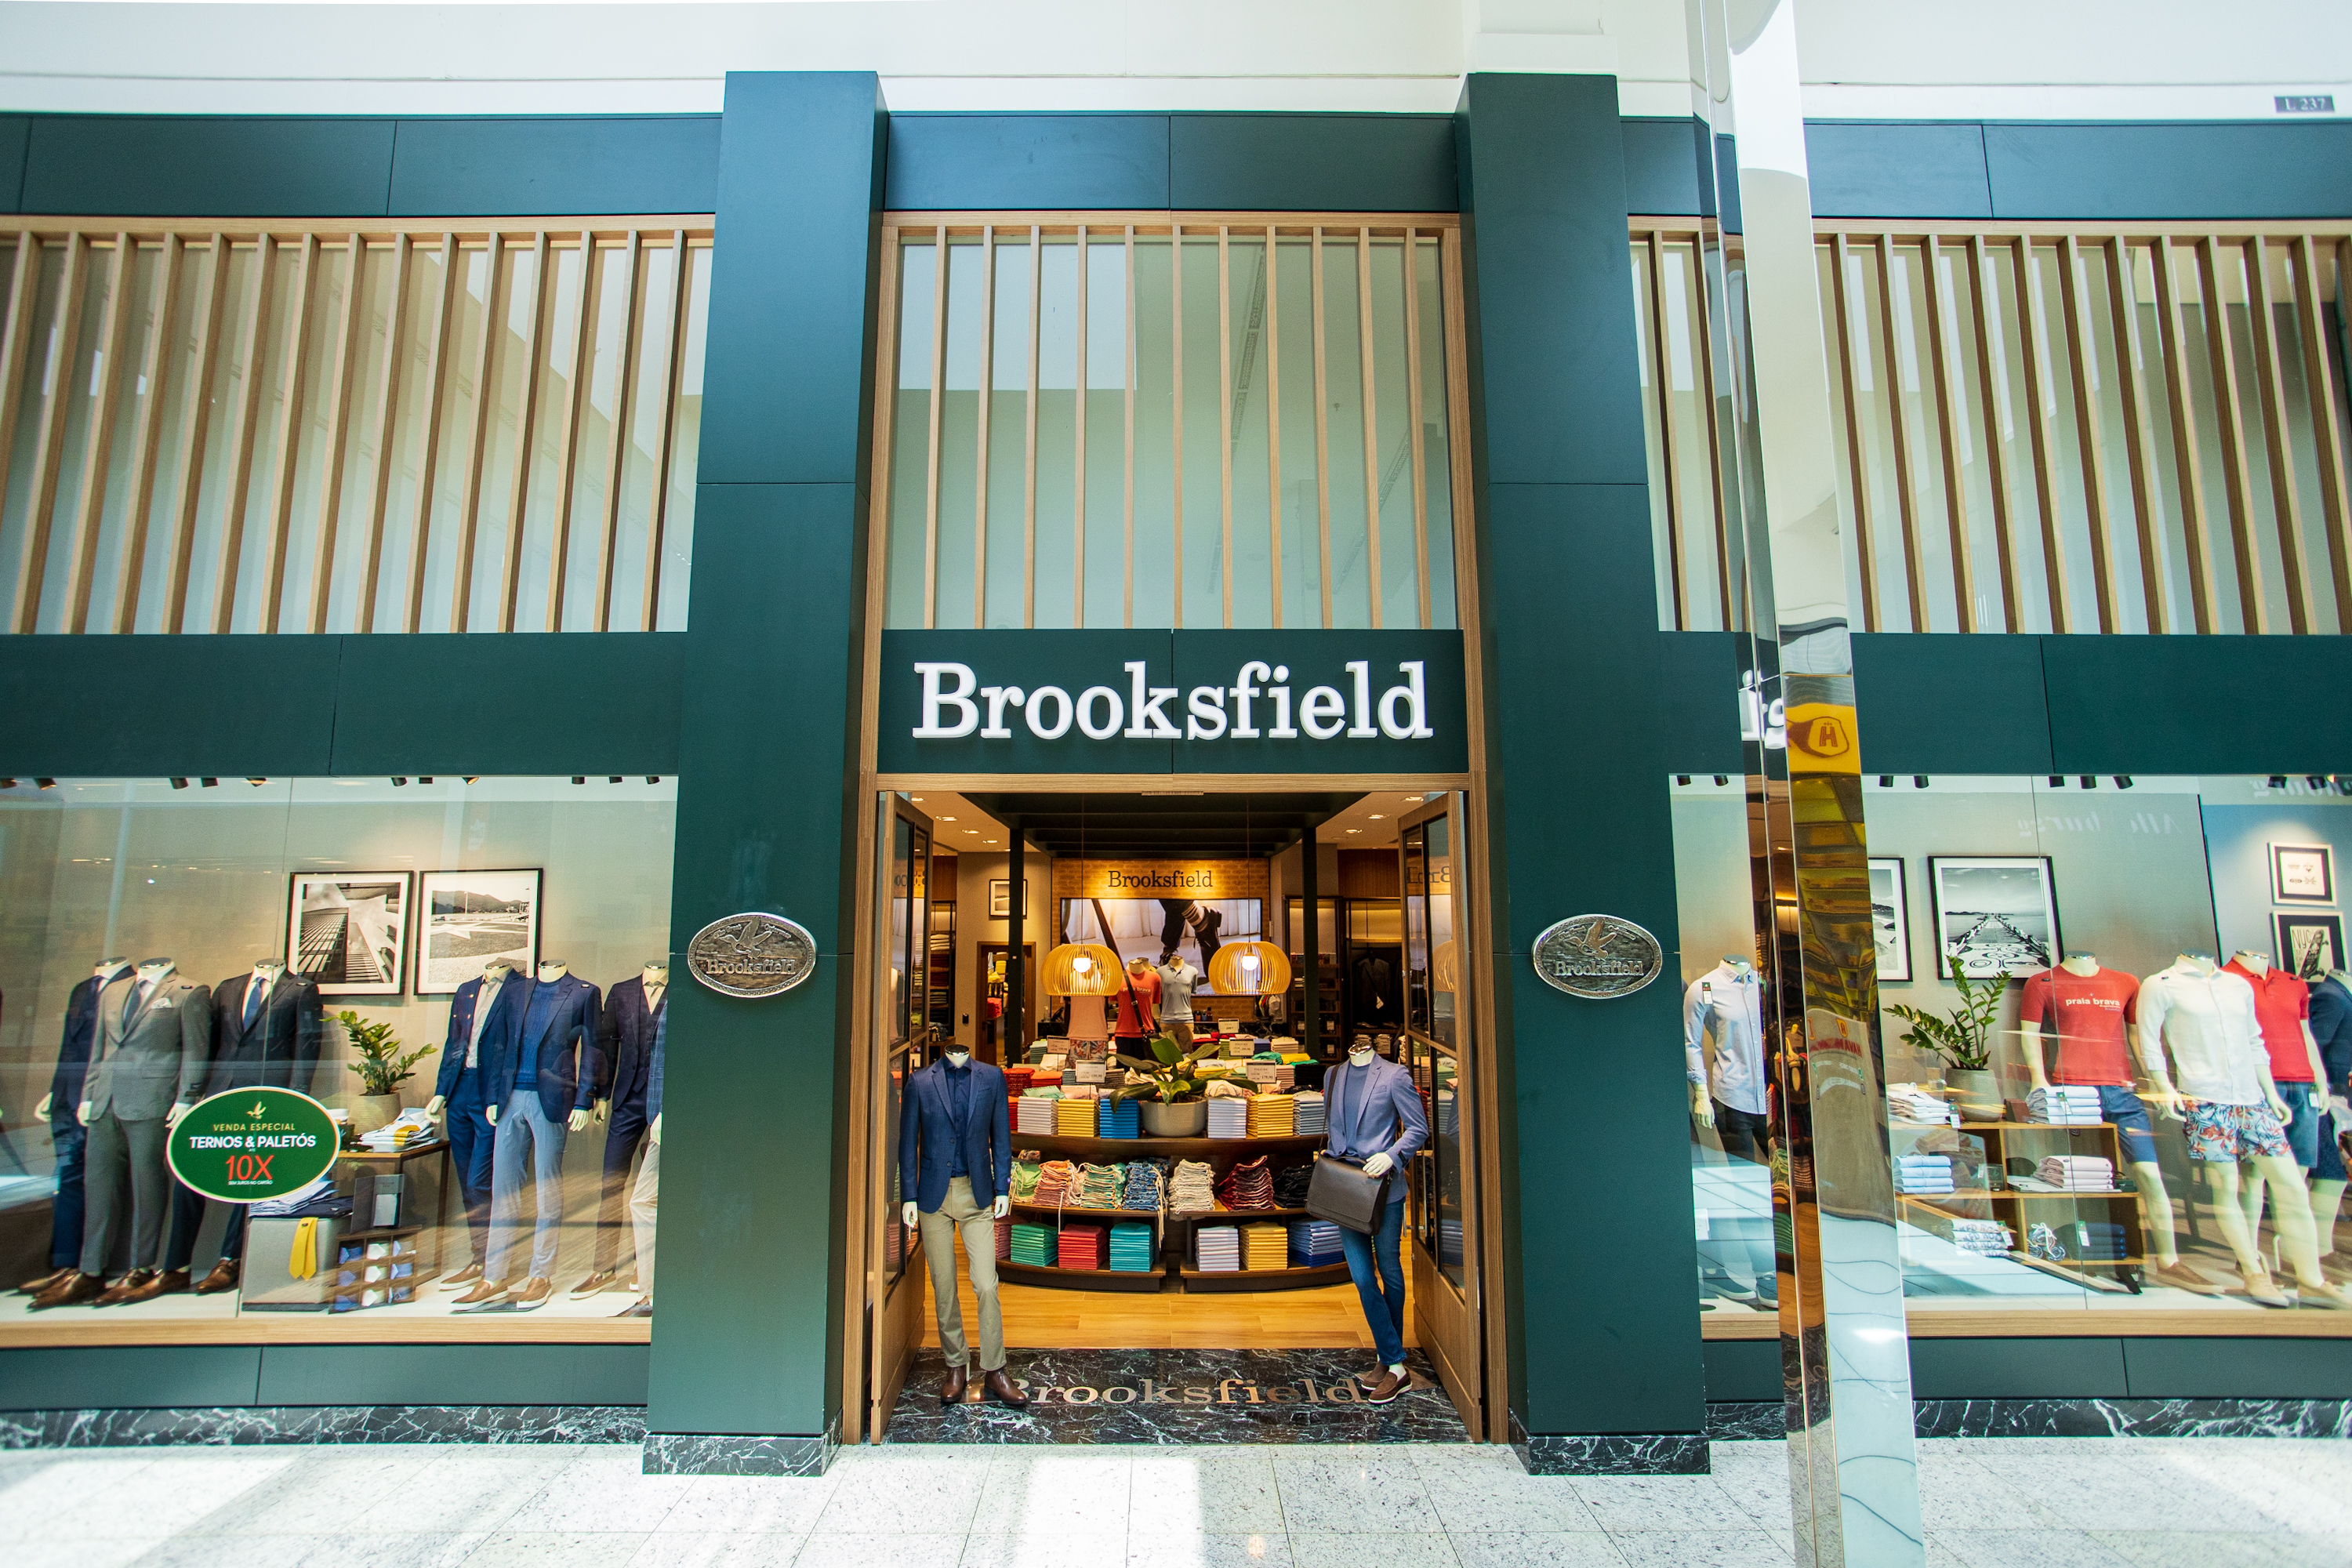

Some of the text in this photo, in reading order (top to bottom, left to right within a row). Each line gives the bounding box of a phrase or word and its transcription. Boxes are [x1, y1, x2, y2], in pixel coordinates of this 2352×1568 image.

[2285, 97, 2325, 111] L 237
[912, 660, 1434, 741] Brooksfield
[1108, 870, 1213, 887] Brooksfield
[706, 958, 796, 975] Brooksfield
[1553, 960, 1644, 976] Brooksfield
[2065, 998, 2091, 1007] praia
[2092, 997, 2120, 1006] brava
[249, 1123, 296, 1131] ESPECIAL
[189, 1132, 317, 1149] TERNOS & PALETÓS
[225, 1155, 274, 1180] 10X
